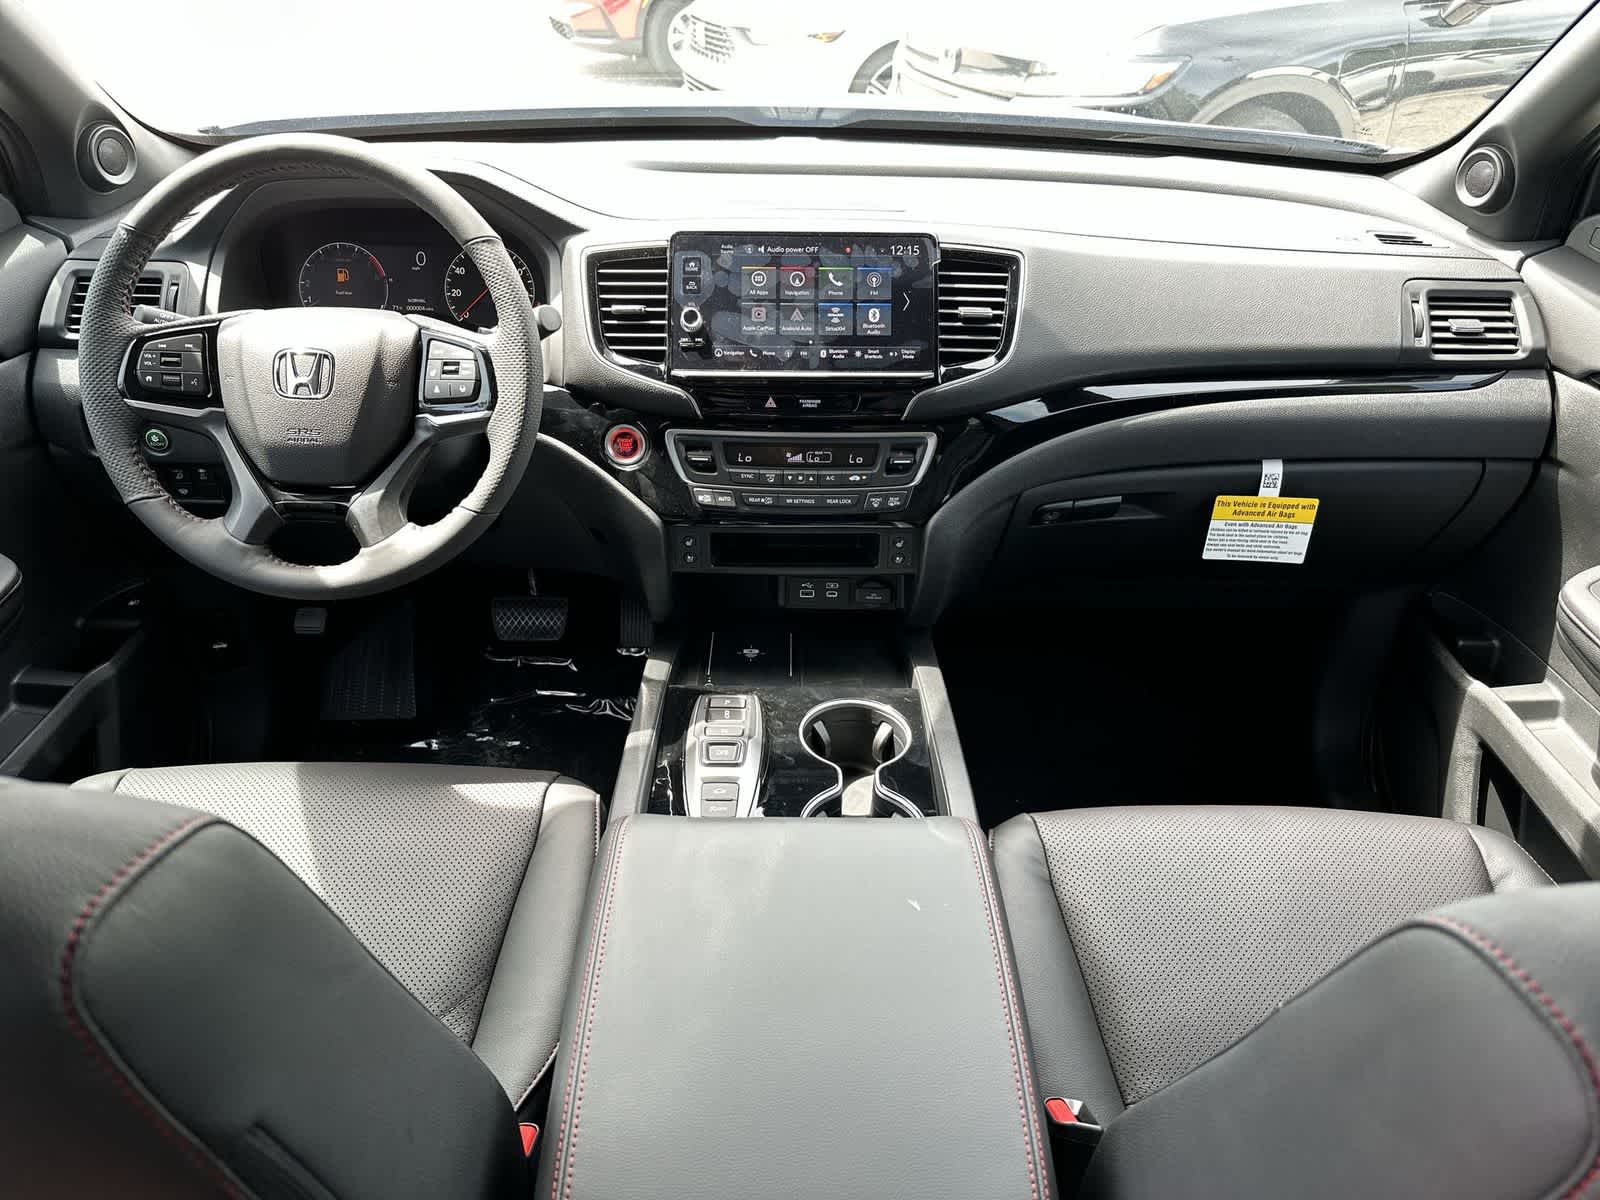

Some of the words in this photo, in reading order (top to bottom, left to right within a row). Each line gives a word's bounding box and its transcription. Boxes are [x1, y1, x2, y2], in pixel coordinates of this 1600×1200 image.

[889, 245, 920, 256] 12:15
[416, 251, 426, 266] 0
[454, 267, 466, 275] 40
[451, 289, 462, 297] 20
[286, 427, 321, 437] SRS
[1217, 500, 1231, 508] This
[1233, 500, 1258, 509] Vehicle
[1267, 501, 1300, 511] Equipped
[1300, 503, 1316, 511] with
[1232, 509, 1266, 517] Advanced
[1278, 511, 1296, 519] Bags
